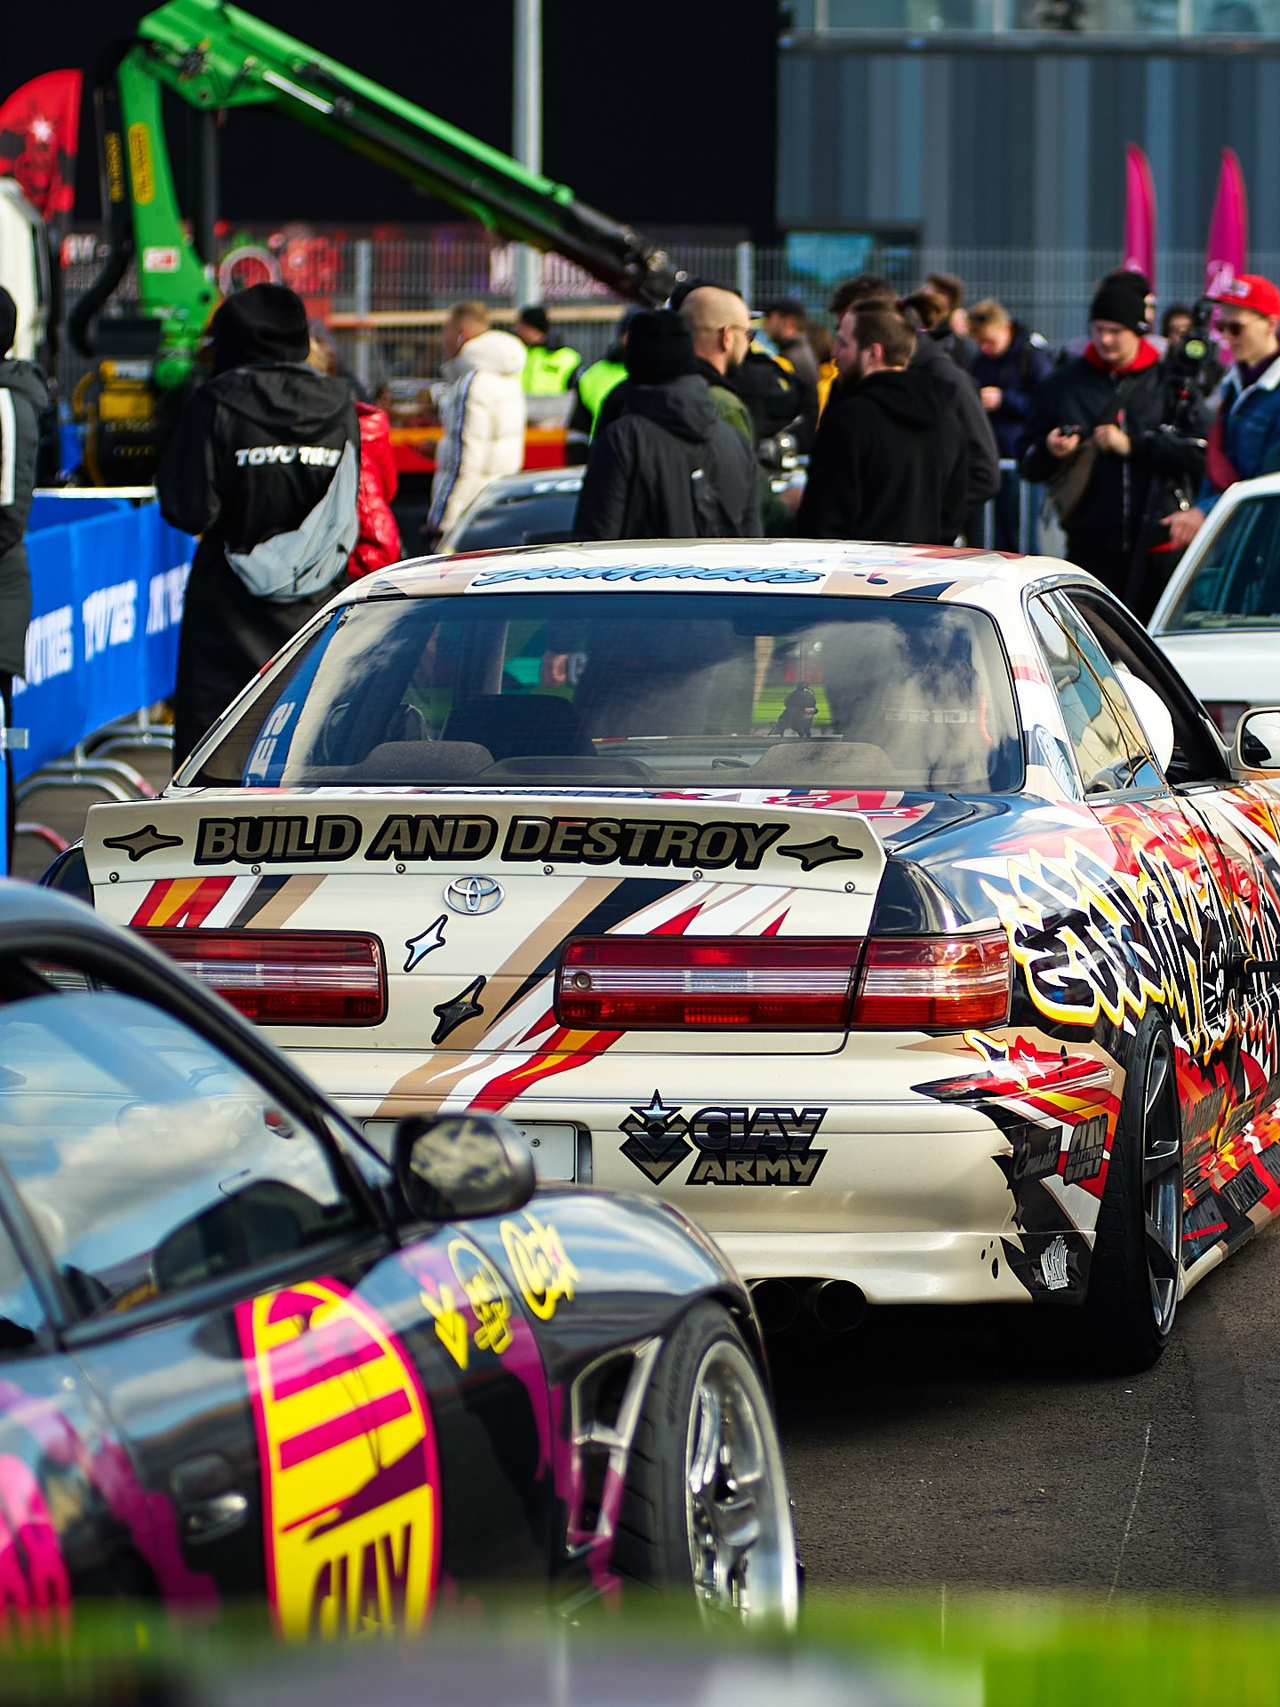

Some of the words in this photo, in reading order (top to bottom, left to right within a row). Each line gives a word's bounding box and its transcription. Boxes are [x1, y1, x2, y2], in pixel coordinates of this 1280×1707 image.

[235, 445, 297, 467] TOYO
[196, 816, 361, 866] BUILD
[364, 814, 500, 866] AND
[500, 816, 790, 870] DESTROY
[687, 1150, 827, 1186] ARMY
